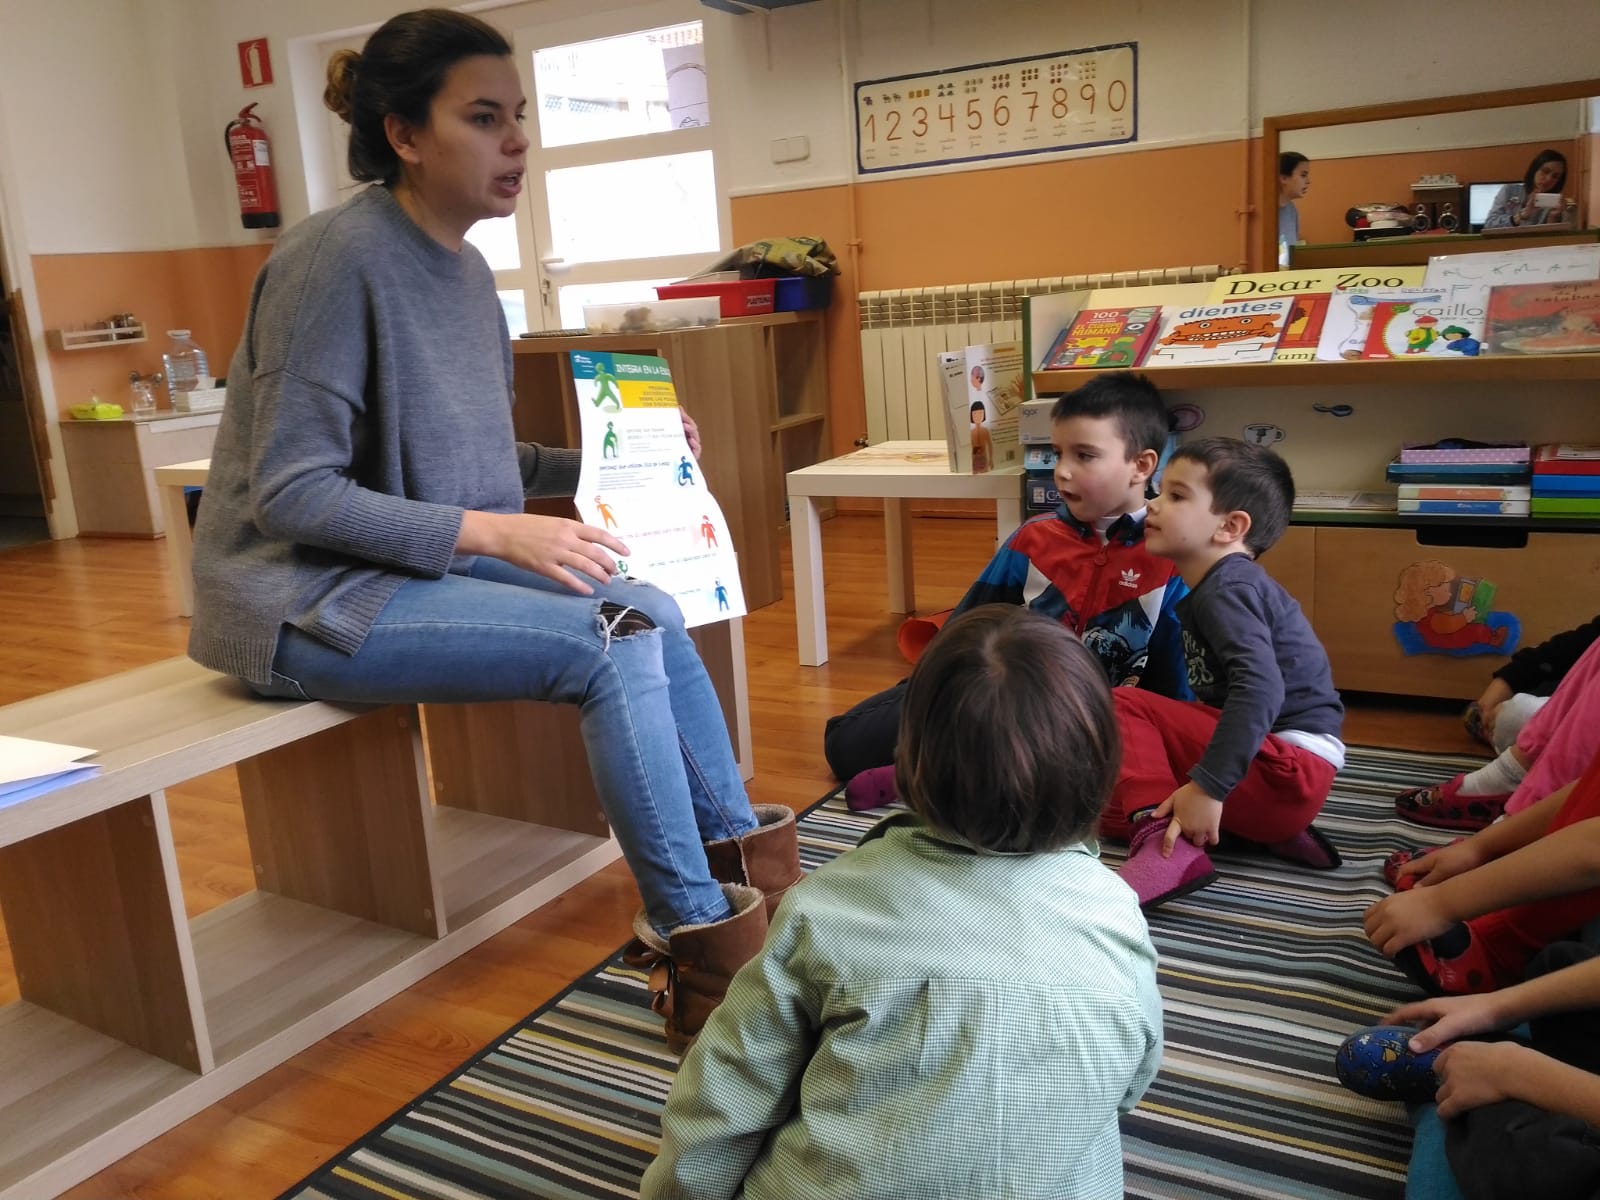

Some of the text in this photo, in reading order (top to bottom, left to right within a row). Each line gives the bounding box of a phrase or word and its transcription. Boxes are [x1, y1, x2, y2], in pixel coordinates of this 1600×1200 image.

[864, 79, 1127, 143] 1 2 3 4 5 6 7 8 9 0
[1228, 273, 1404, 296] Dear Zoo
[1092, 311, 1120, 319] 100
[1179, 300, 1283, 320] dientes
[1412, 303, 1484, 317] caillo
[1072, 327, 1120, 336] HUMANO
